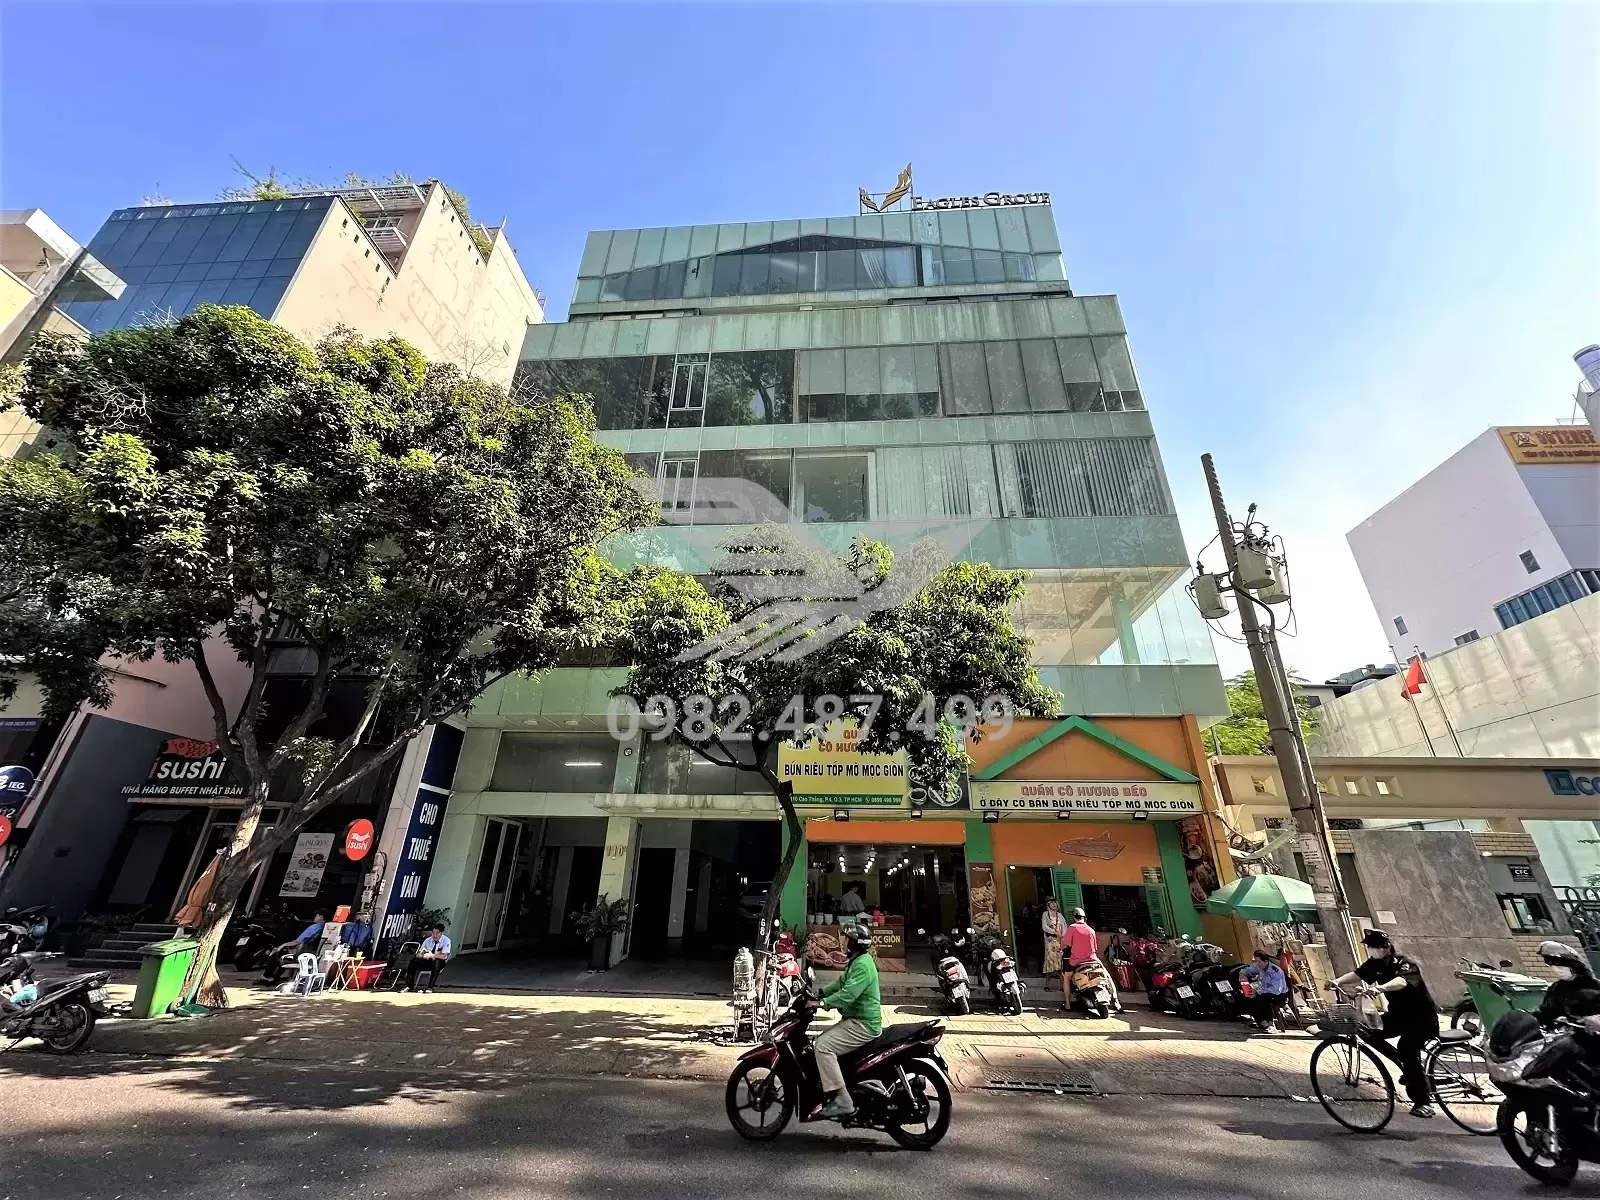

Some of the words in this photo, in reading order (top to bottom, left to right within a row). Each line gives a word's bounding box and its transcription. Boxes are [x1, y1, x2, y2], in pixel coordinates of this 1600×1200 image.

[784, 759, 801, 776] BÚN
[804, 761, 824, 776] RIÊU
[827, 760, 843, 776] TÓP
[862, 764, 880, 779] MỌC
[883, 760, 904, 777] GIÒN
[8, 780, 25, 790] IEG
[121, 784, 140, 794] NHÀ
[142, 785, 169, 794] HÀNG
[169, 786, 199, 795] BUFFET
[199, 784, 224, 797] NHẬT
[224, 784, 244, 795] BẢN
[1021, 783, 1054, 796] QUÁN
[1058, 785, 1074, 797] CÔ
[1077, 785, 1119, 797] HƯƠNG
[1123, 784, 1148, 797] BÉO
[980, 795, 986, 807] Ở
[989, 797, 1009, 807] ĐÂY
[1012, 797, 1026, 808] CÓ
[1029, 797, 1049, 808] BÁN
[1052, 797, 1073, 808] BÚN
[1076, 798, 1099, 808] RIÊU
[1102, 798, 1122, 809] TÓP
[1145, 800, 1167, 810] MỌC
[420, 802, 439, 825] CHO
[347, 840, 368, 851] isushi
[400, 871, 421, 898] VĂN
[382, 908, 415, 938] PHÒN
